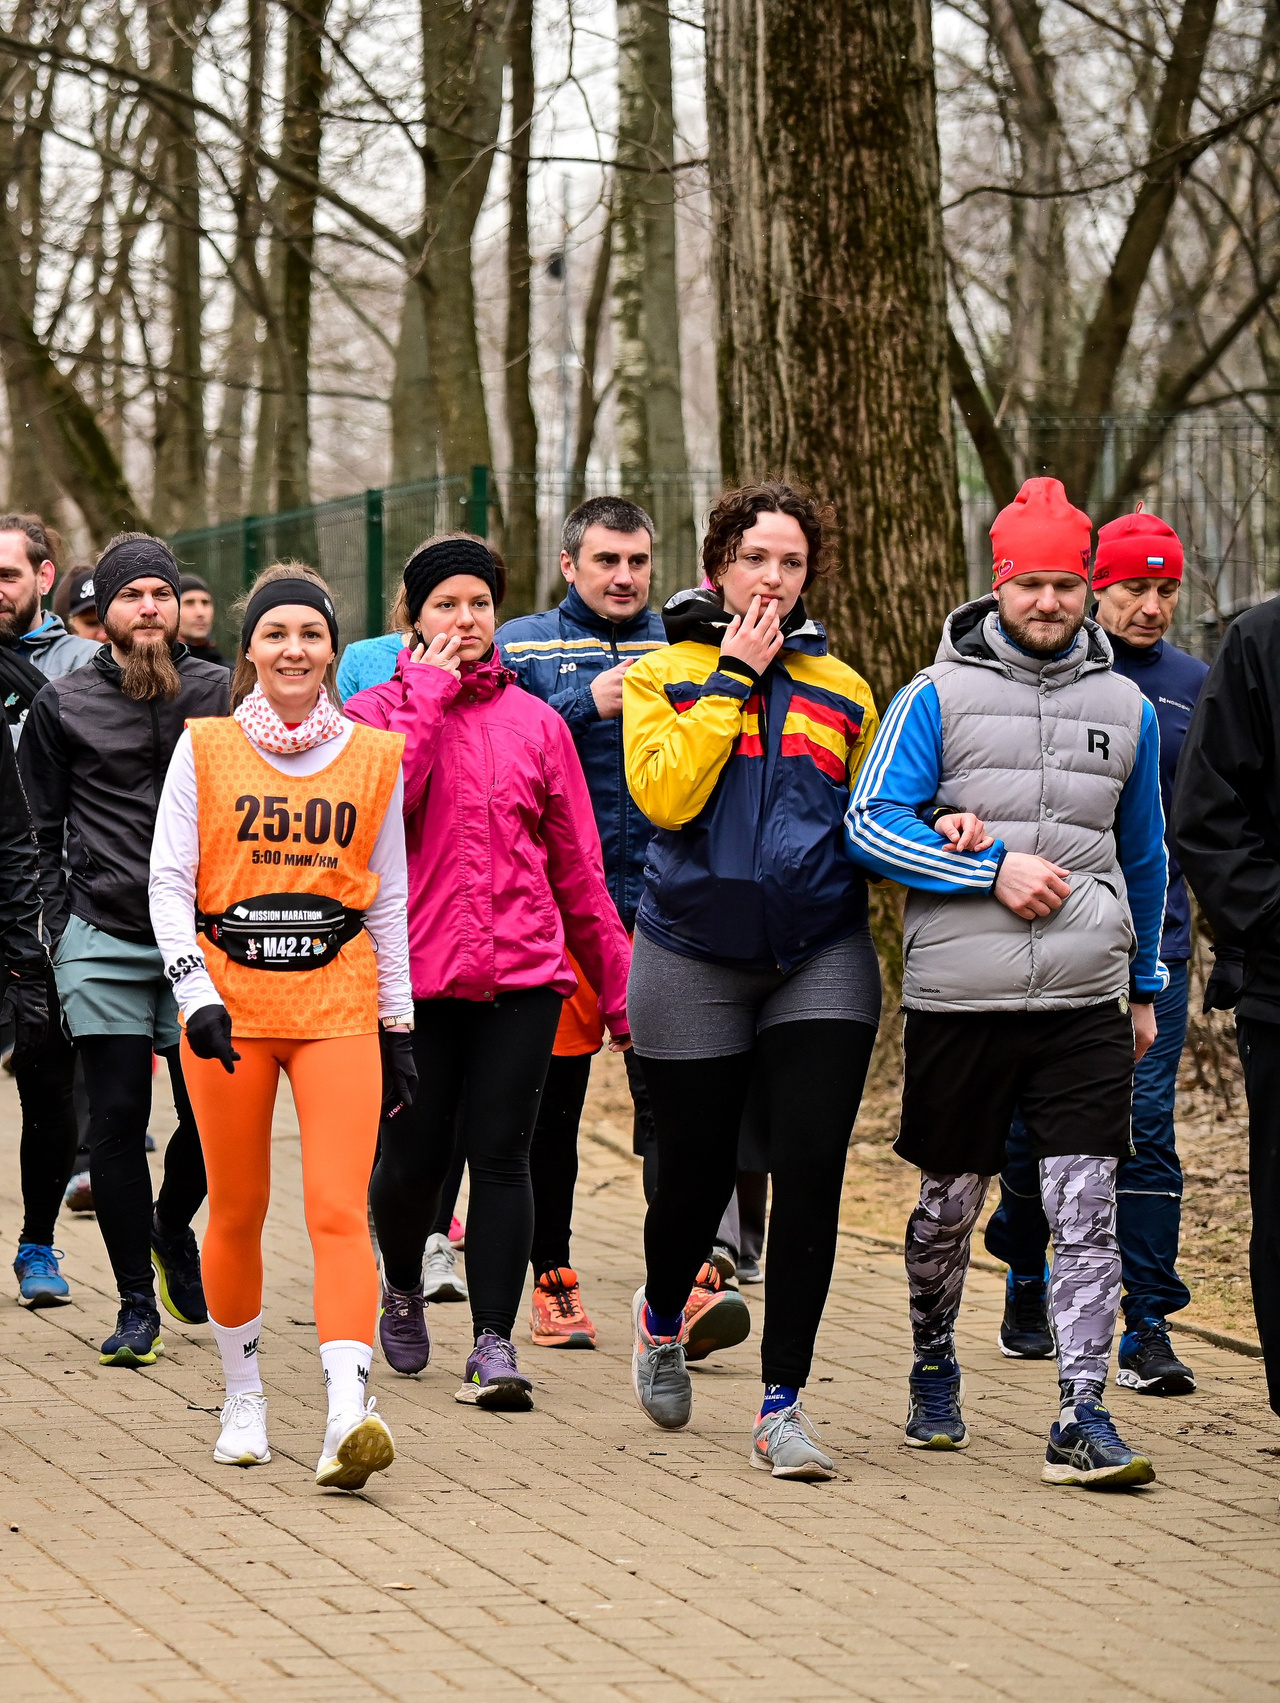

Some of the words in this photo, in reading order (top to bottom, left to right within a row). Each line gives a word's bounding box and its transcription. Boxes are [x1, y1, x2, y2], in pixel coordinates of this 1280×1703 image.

[1087, 728, 1110, 761] R
[235, 795, 357, 848] 25:00
[252, 850, 281, 864] 5:00
[249, 911, 280, 921] MISSION
[281, 910, 323, 921] MARATHON
[263, 936, 312, 957] M42.2
